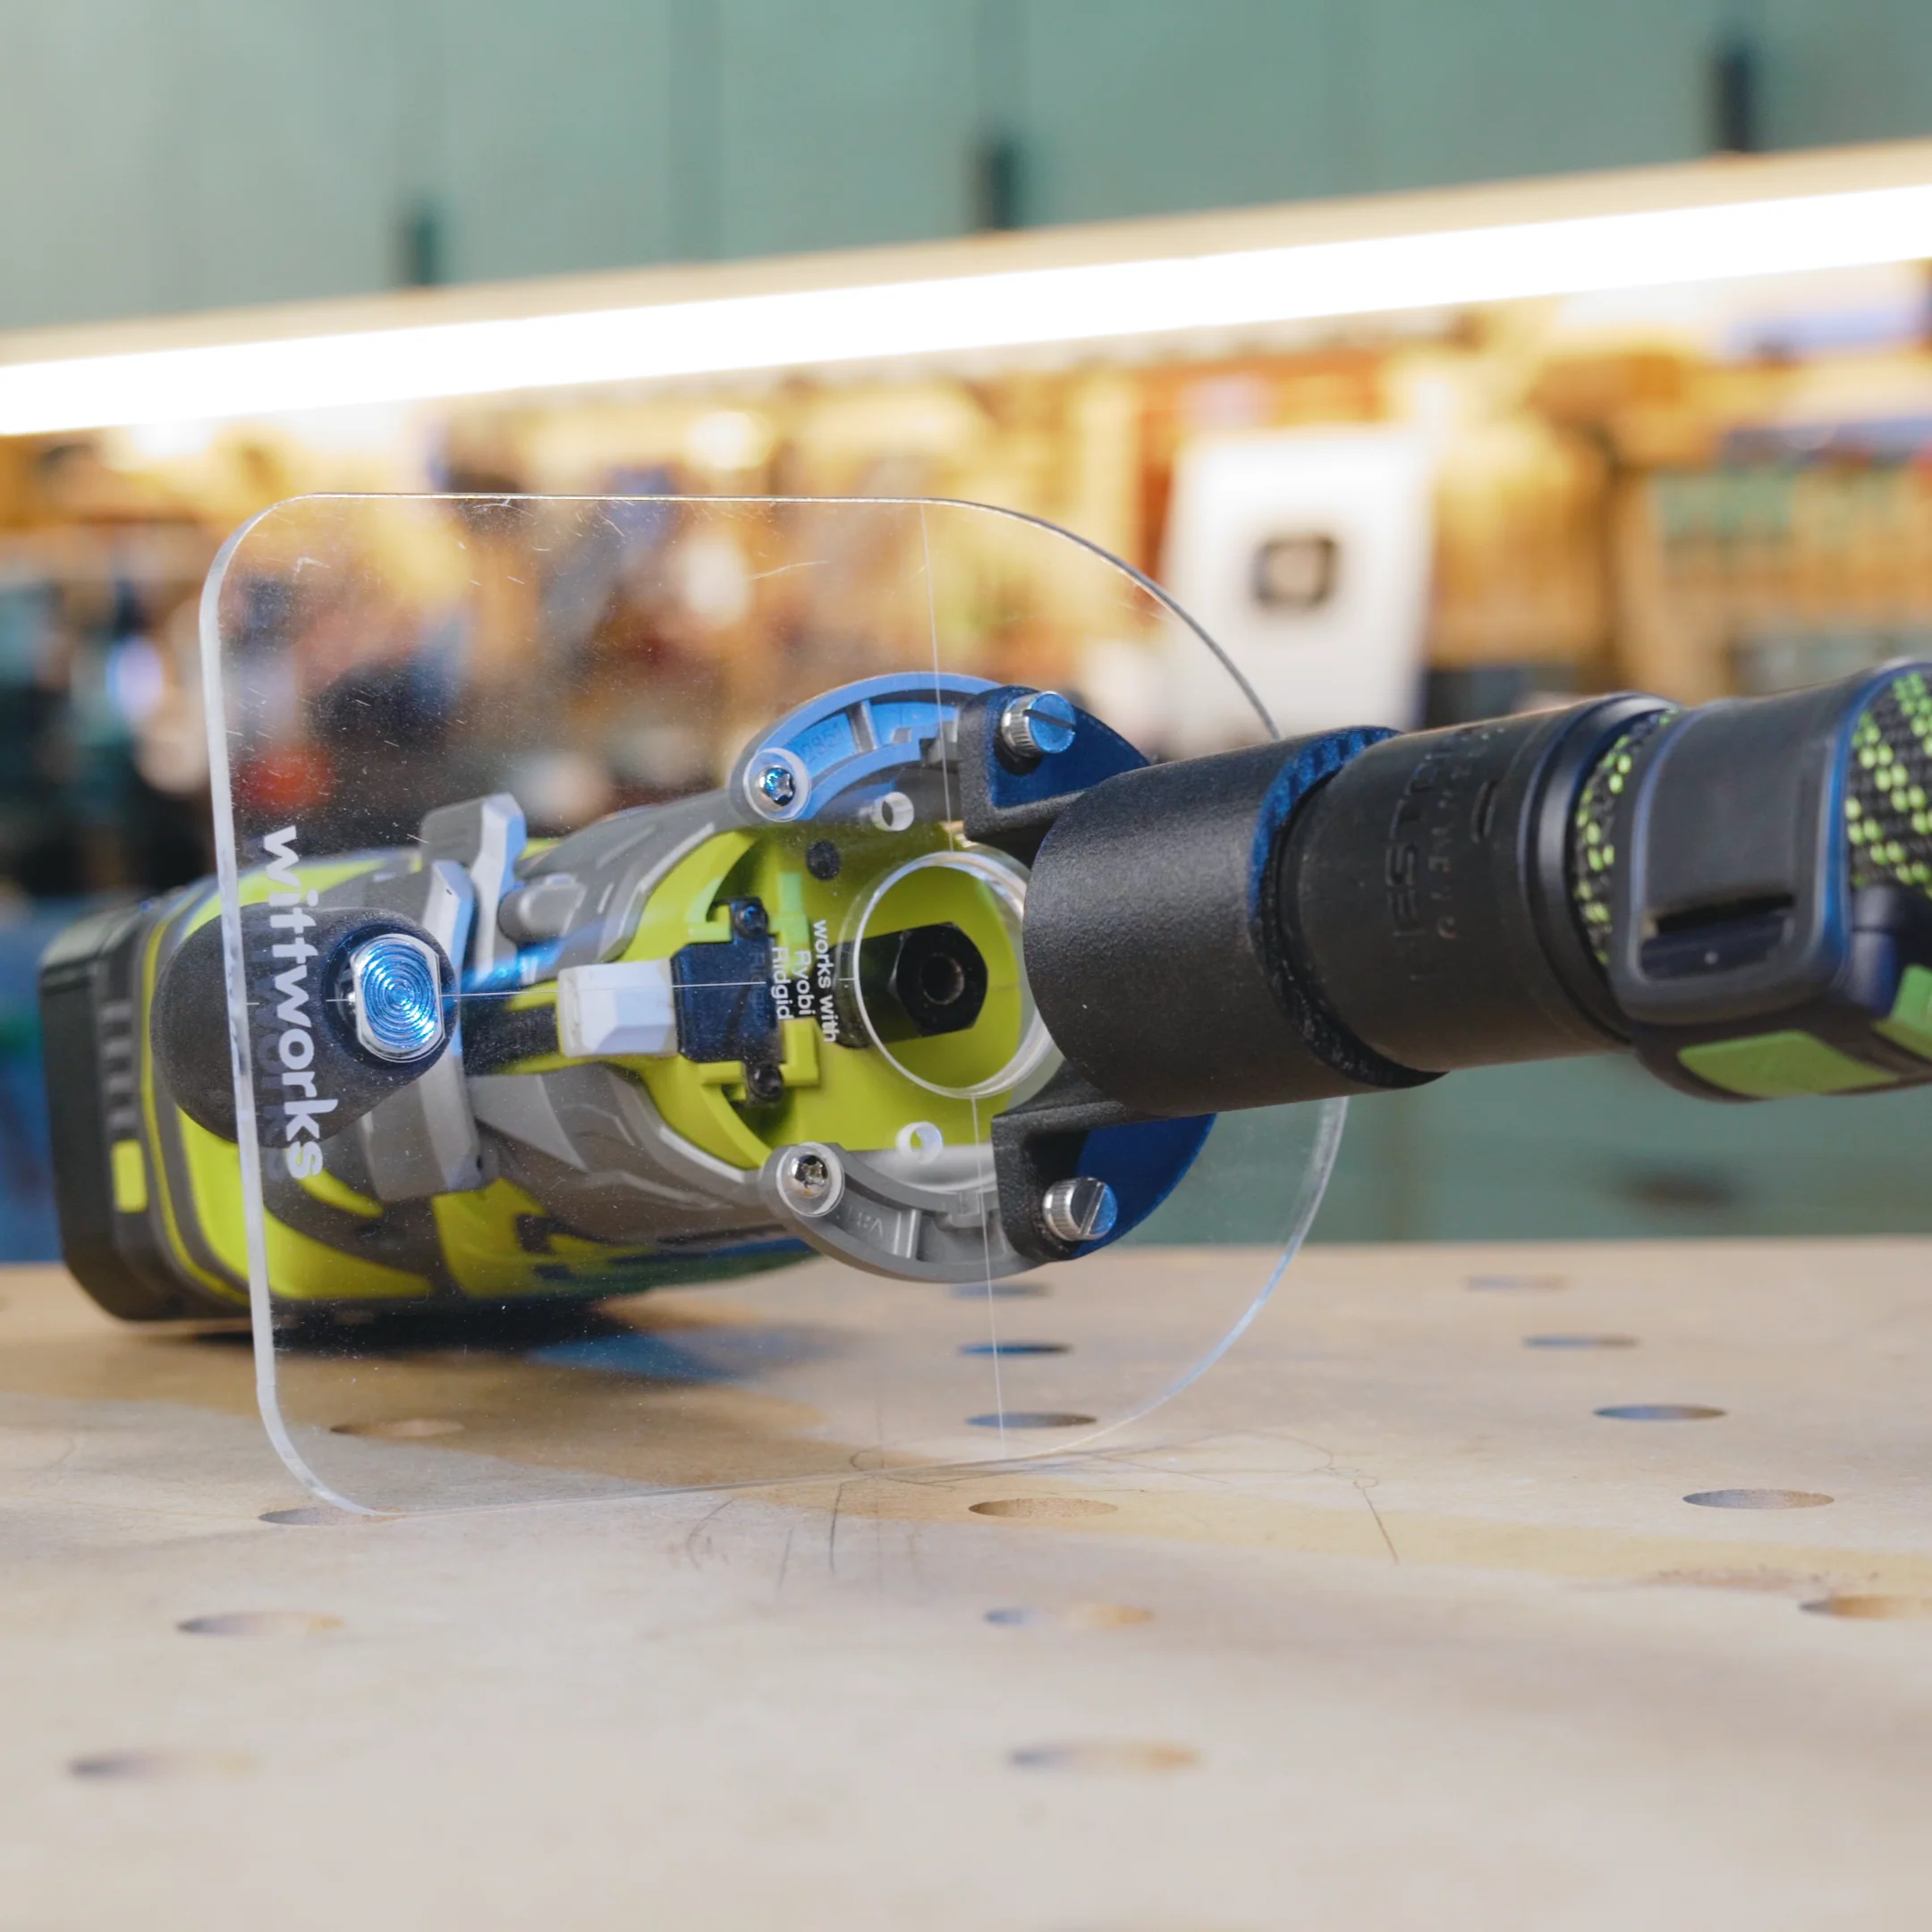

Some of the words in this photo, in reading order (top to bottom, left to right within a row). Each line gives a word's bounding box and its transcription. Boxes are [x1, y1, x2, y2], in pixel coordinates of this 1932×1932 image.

[770, 946, 794, 1021] Ridgid
[792, 949, 817, 1016] Ryobi
[813, 919, 835, 989] works
[264, 826, 338, 1180] wittworks
[818, 995, 841, 1043] with
